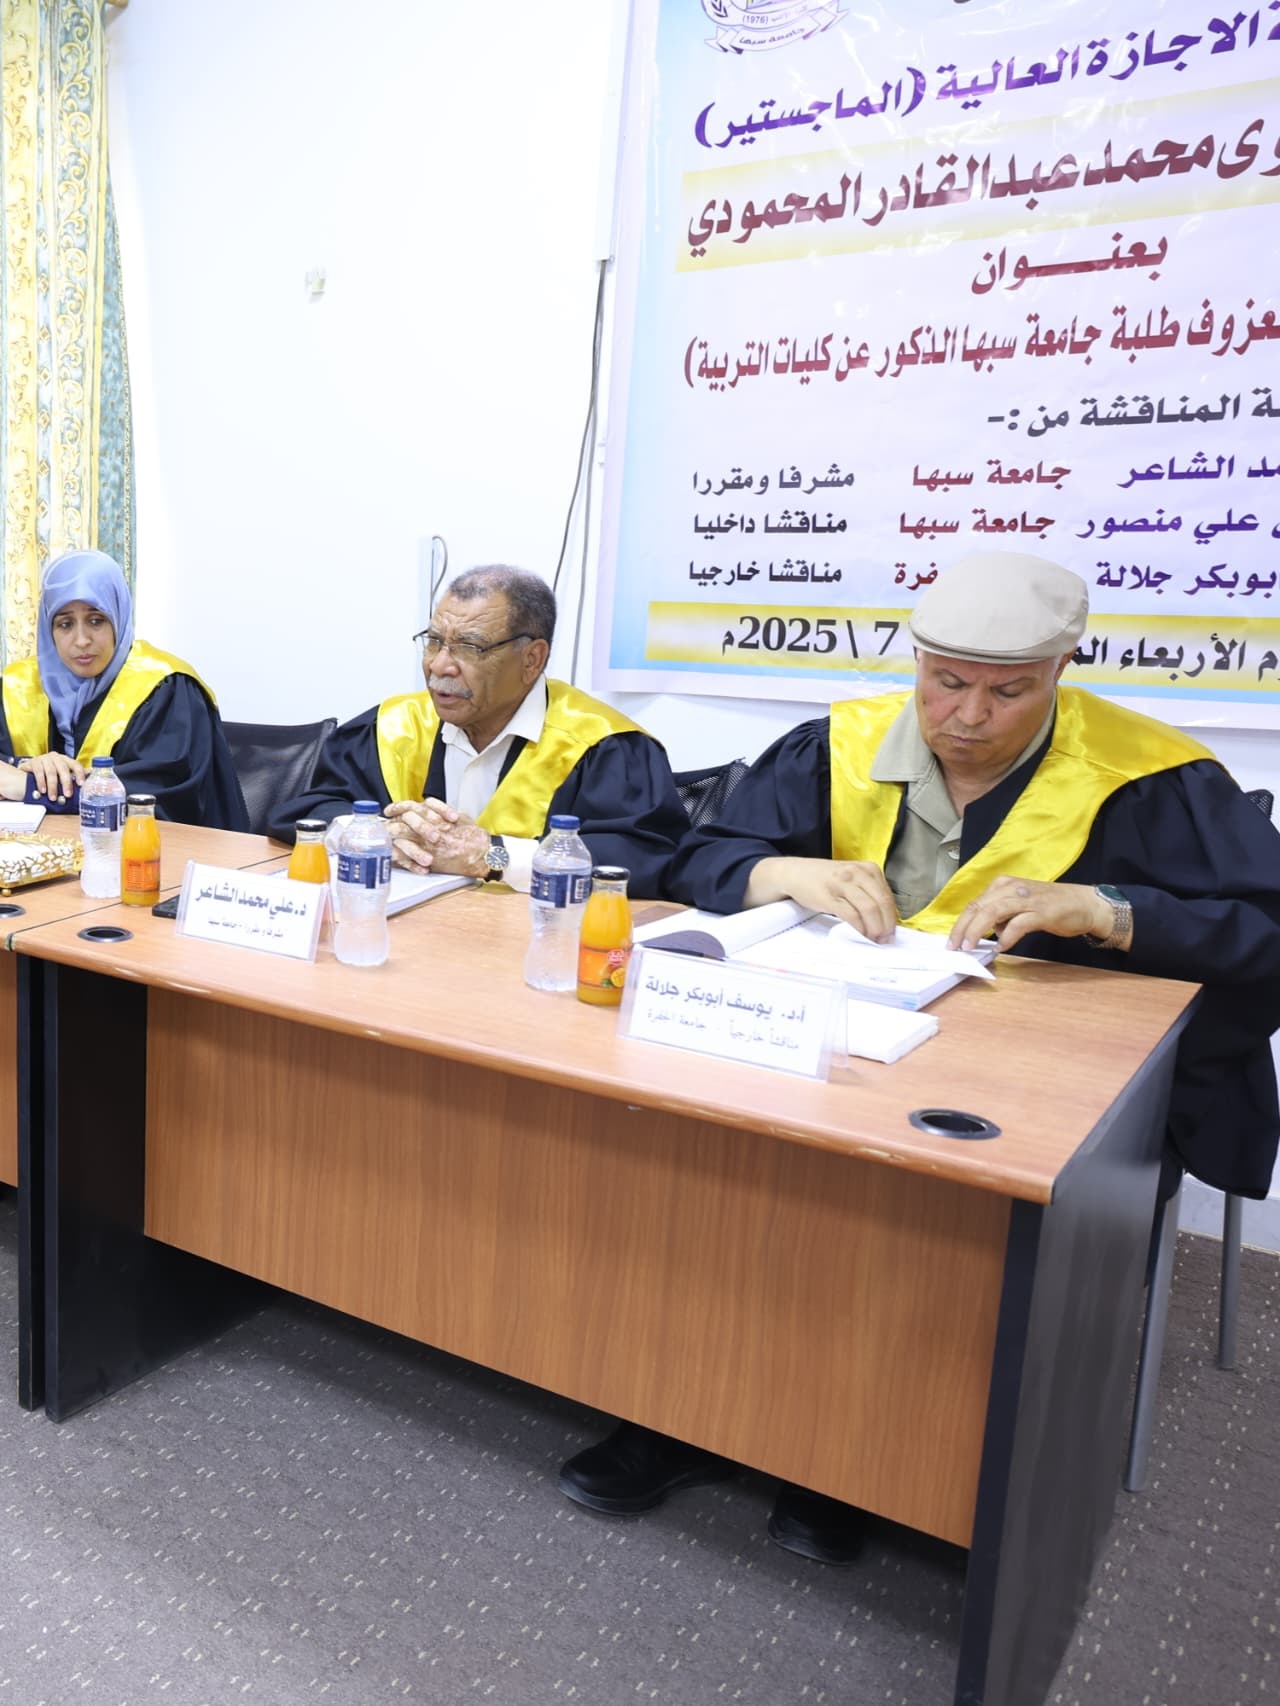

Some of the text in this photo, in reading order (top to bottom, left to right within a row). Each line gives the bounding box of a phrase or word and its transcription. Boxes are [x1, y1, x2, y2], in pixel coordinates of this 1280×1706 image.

[742, 15, 768, 24] (1976)
[936, 44, 1080, 110] العالية
[695, 66, 926, 148] (الماجستير)
[1083, 134, 1215, 186] محمد
[688, 171, 862, 258] المحمودي
[684, 298, 1280, 392] عزوف طلبة جامعة سبها الذكور عن كليات التربية)
[1080, 392, 1241, 426] المناقشة
[779, 463, 855, 494] مشرفا
[913, 464, 973, 493] سبها
[987, 459, 1071, 490] جامعة
[1117, 450, 1235, 488] الشاعر
[694, 512, 756, 540] داخليا
[764, 509, 848, 534] مناقشا
[899, 511, 960, 540] سبها
[972, 508, 1055, 540] جامعة
[1075, 508, 1182, 540] منصور
[1194, 508, 1260, 545] علي
[689, 558, 1280, 599] بوبكر جلالة فرة مناقشا خارجيا
[1120, 632, 1247, 681] الأربعاء
[195, 882, 239, 902] الشاعر
[238, 890, 269, 909] محمد
[645, 976, 680, 1000] جلالة
[726, 992, 773, 1020] يوسف
